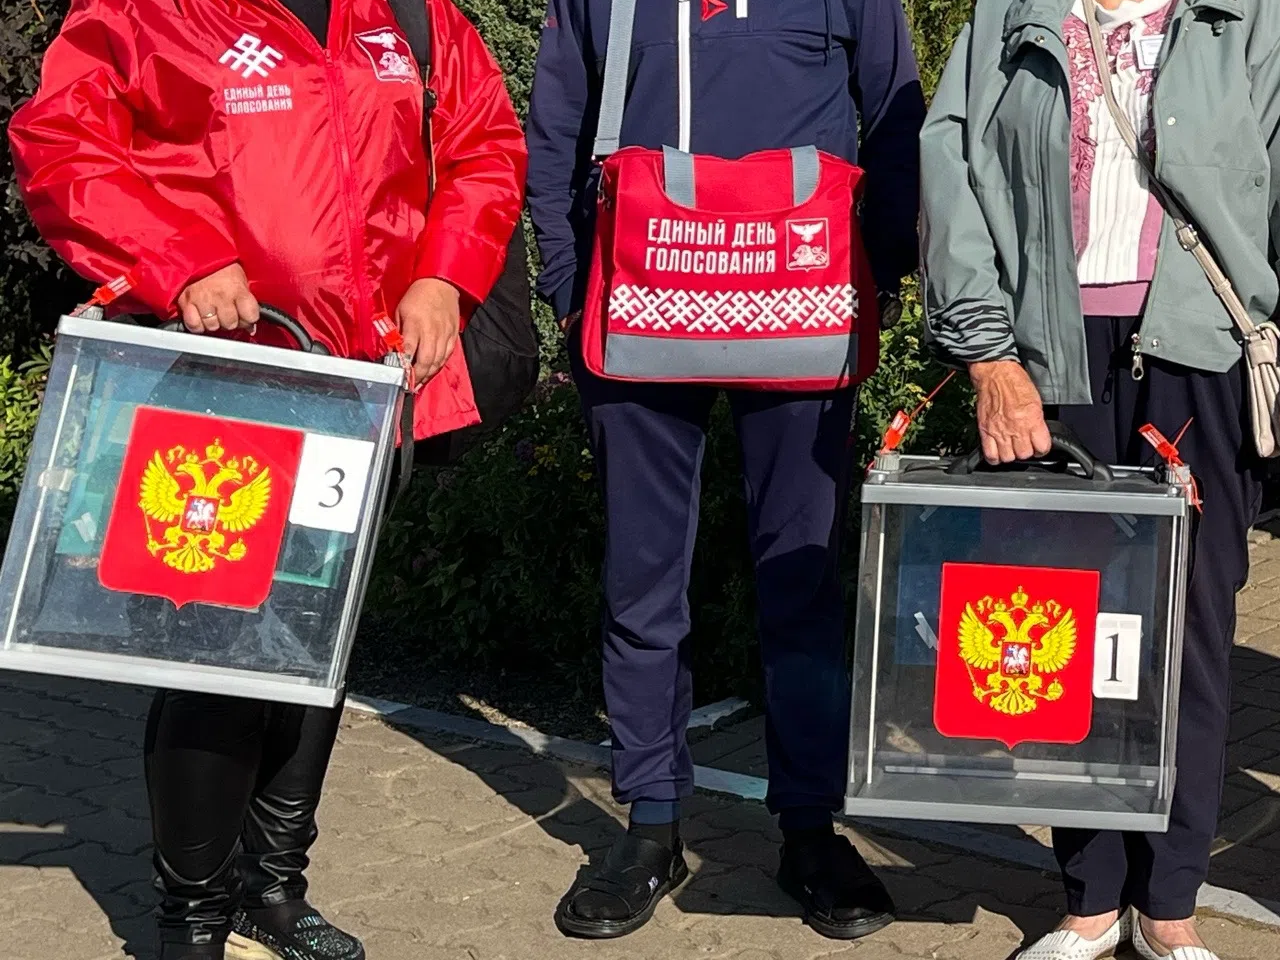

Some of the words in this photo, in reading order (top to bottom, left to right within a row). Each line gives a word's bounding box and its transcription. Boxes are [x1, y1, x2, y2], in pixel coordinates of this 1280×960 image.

[223, 84, 264, 101] ЕДИНЫЙ
[266, 84, 291, 99] ДЕНЬ
[225, 98, 293, 115] ГОЛОСОВАНИЯ
[647, 217, 726, 246] ЕДИНЫЙ
[731, 221, 776, 248] ДЕНЬ
[645, 246, 776, 275] ГОЛОСОВАНИЯ
[318, 467, 346, 509] 3
[1103, 632, 1123, 683] 1
